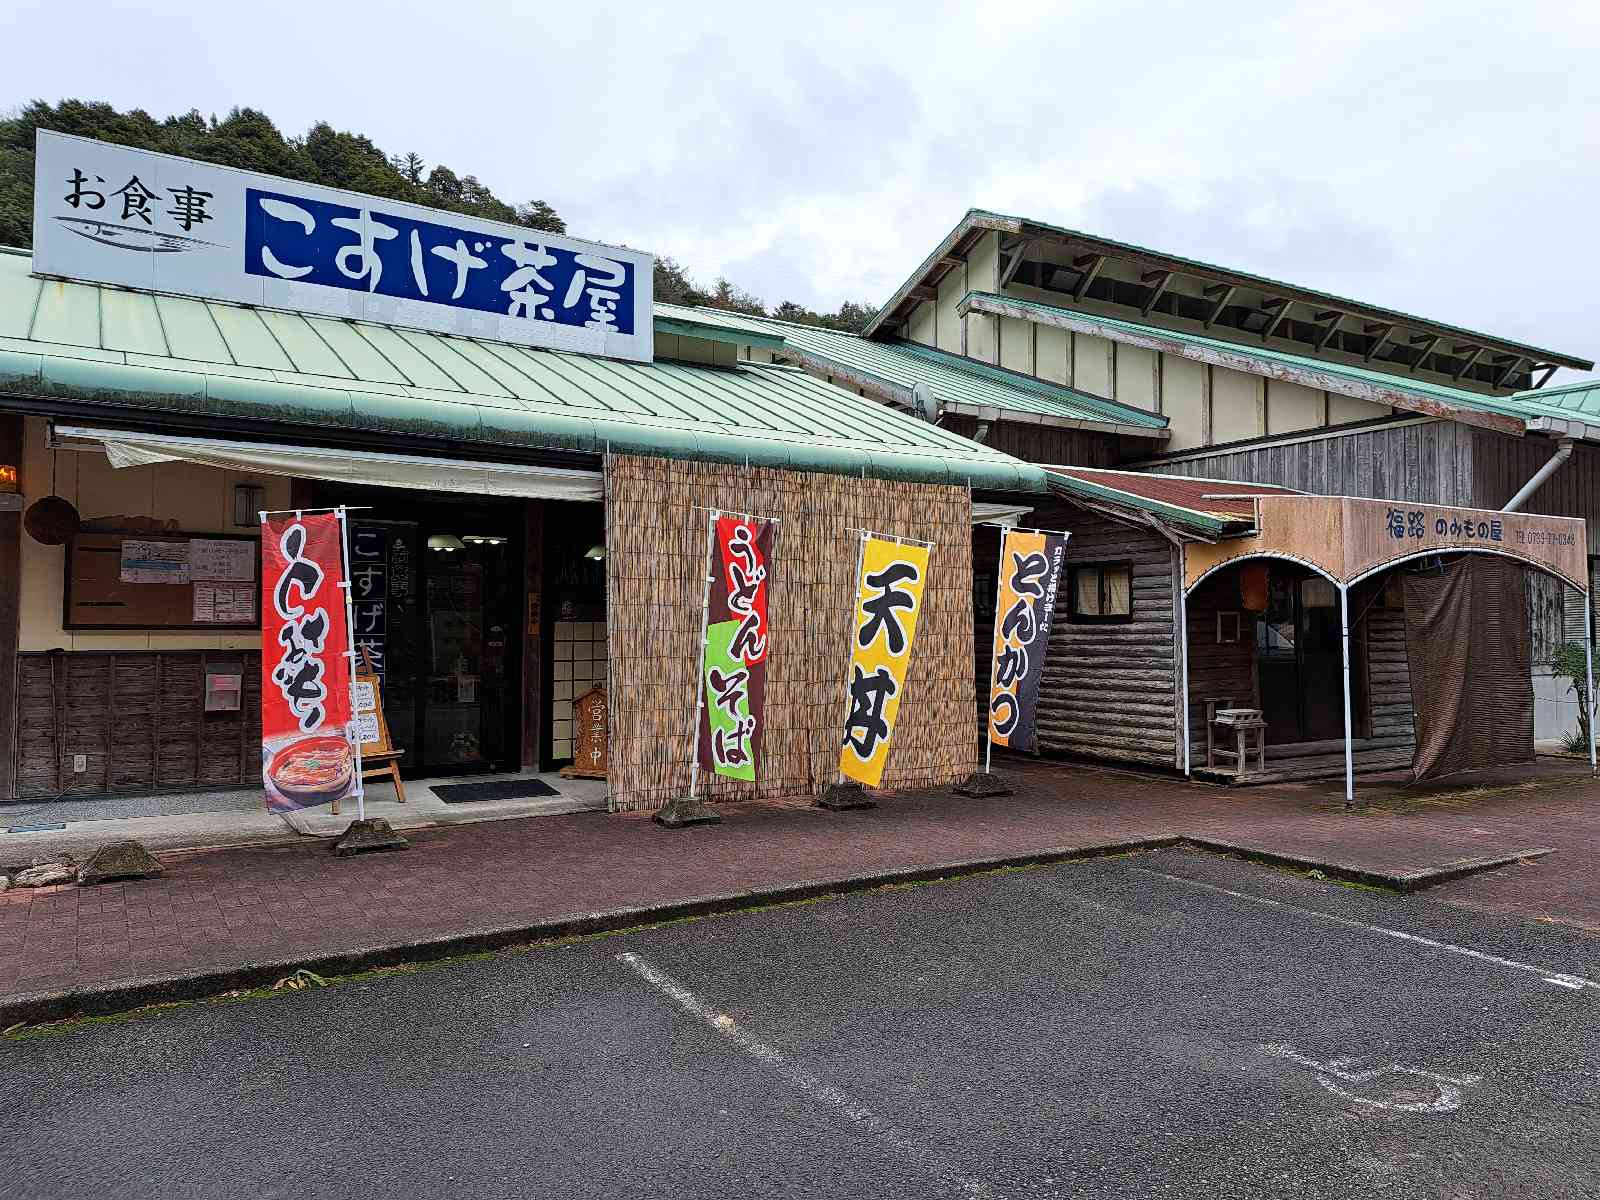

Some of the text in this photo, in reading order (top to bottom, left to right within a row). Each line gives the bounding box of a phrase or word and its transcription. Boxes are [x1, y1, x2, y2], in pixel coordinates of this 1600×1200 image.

[64, 167, 214, 232] お食事
[258, 197, 627, 333] こすげ茶屋
[1435, 517, 1504, 541] のみもの屋
[708, 525, 766, 768] うどん そば
[842, 560, 920, 761] 天丼
[990, 550, 1049, 738] とんかつ
